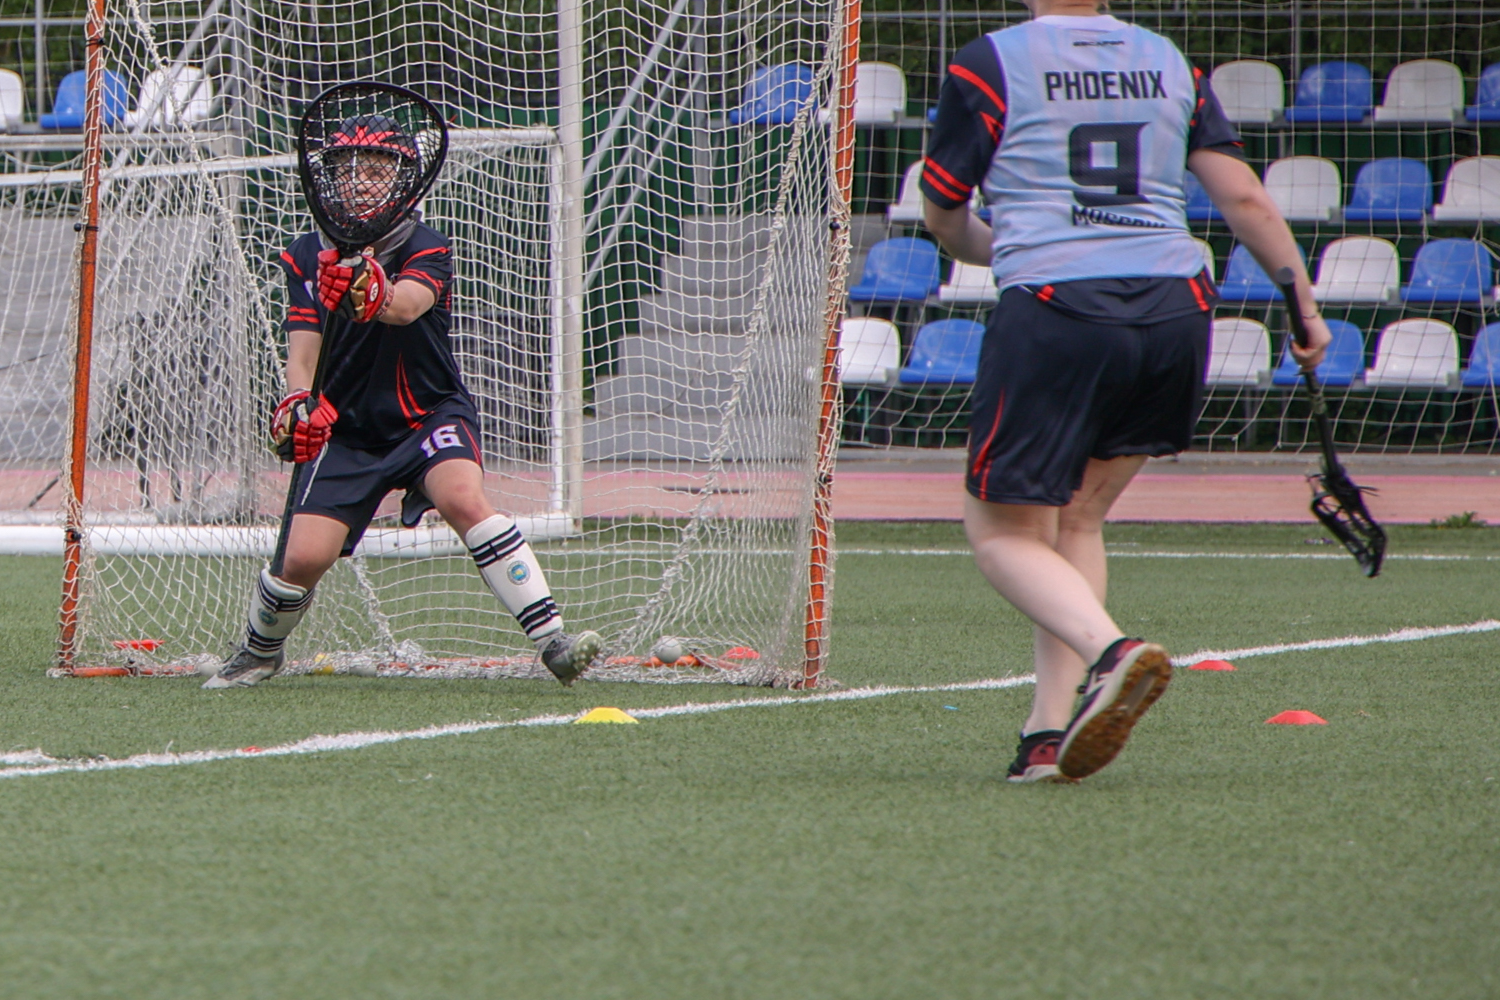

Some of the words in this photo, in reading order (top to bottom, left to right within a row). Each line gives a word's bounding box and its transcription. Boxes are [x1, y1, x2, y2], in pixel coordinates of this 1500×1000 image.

[1044, 69, 1168, 101] PHOENIX
[1068, 121, 1153, 208] 9
[420, 424, 466, 458] 16
